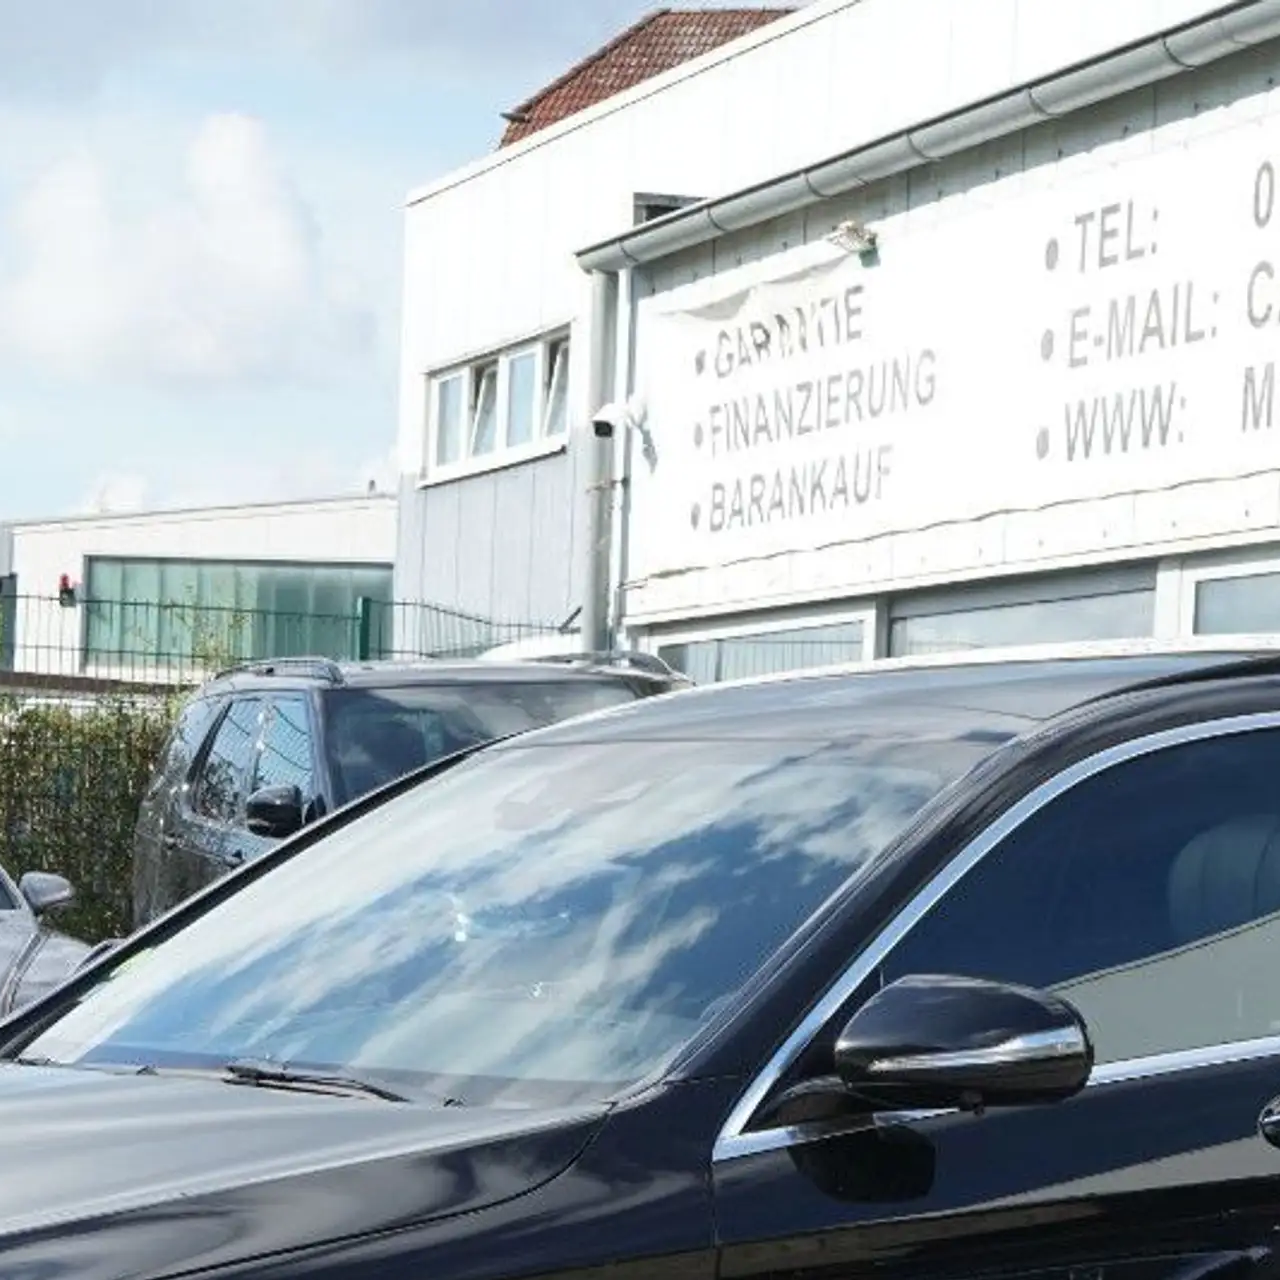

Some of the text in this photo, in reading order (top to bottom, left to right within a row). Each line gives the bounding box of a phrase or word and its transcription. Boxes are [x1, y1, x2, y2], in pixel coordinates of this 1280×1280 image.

[1074, 197, 1160, 273] TEL:
[1067, 280, 1220, 369] E-MAIL:
[708, 348, 937, 459] FINANZIERUNG
[1064, 381, 1187, 462] WWW:
[707, 444, 894, 533] BARANKAUF
